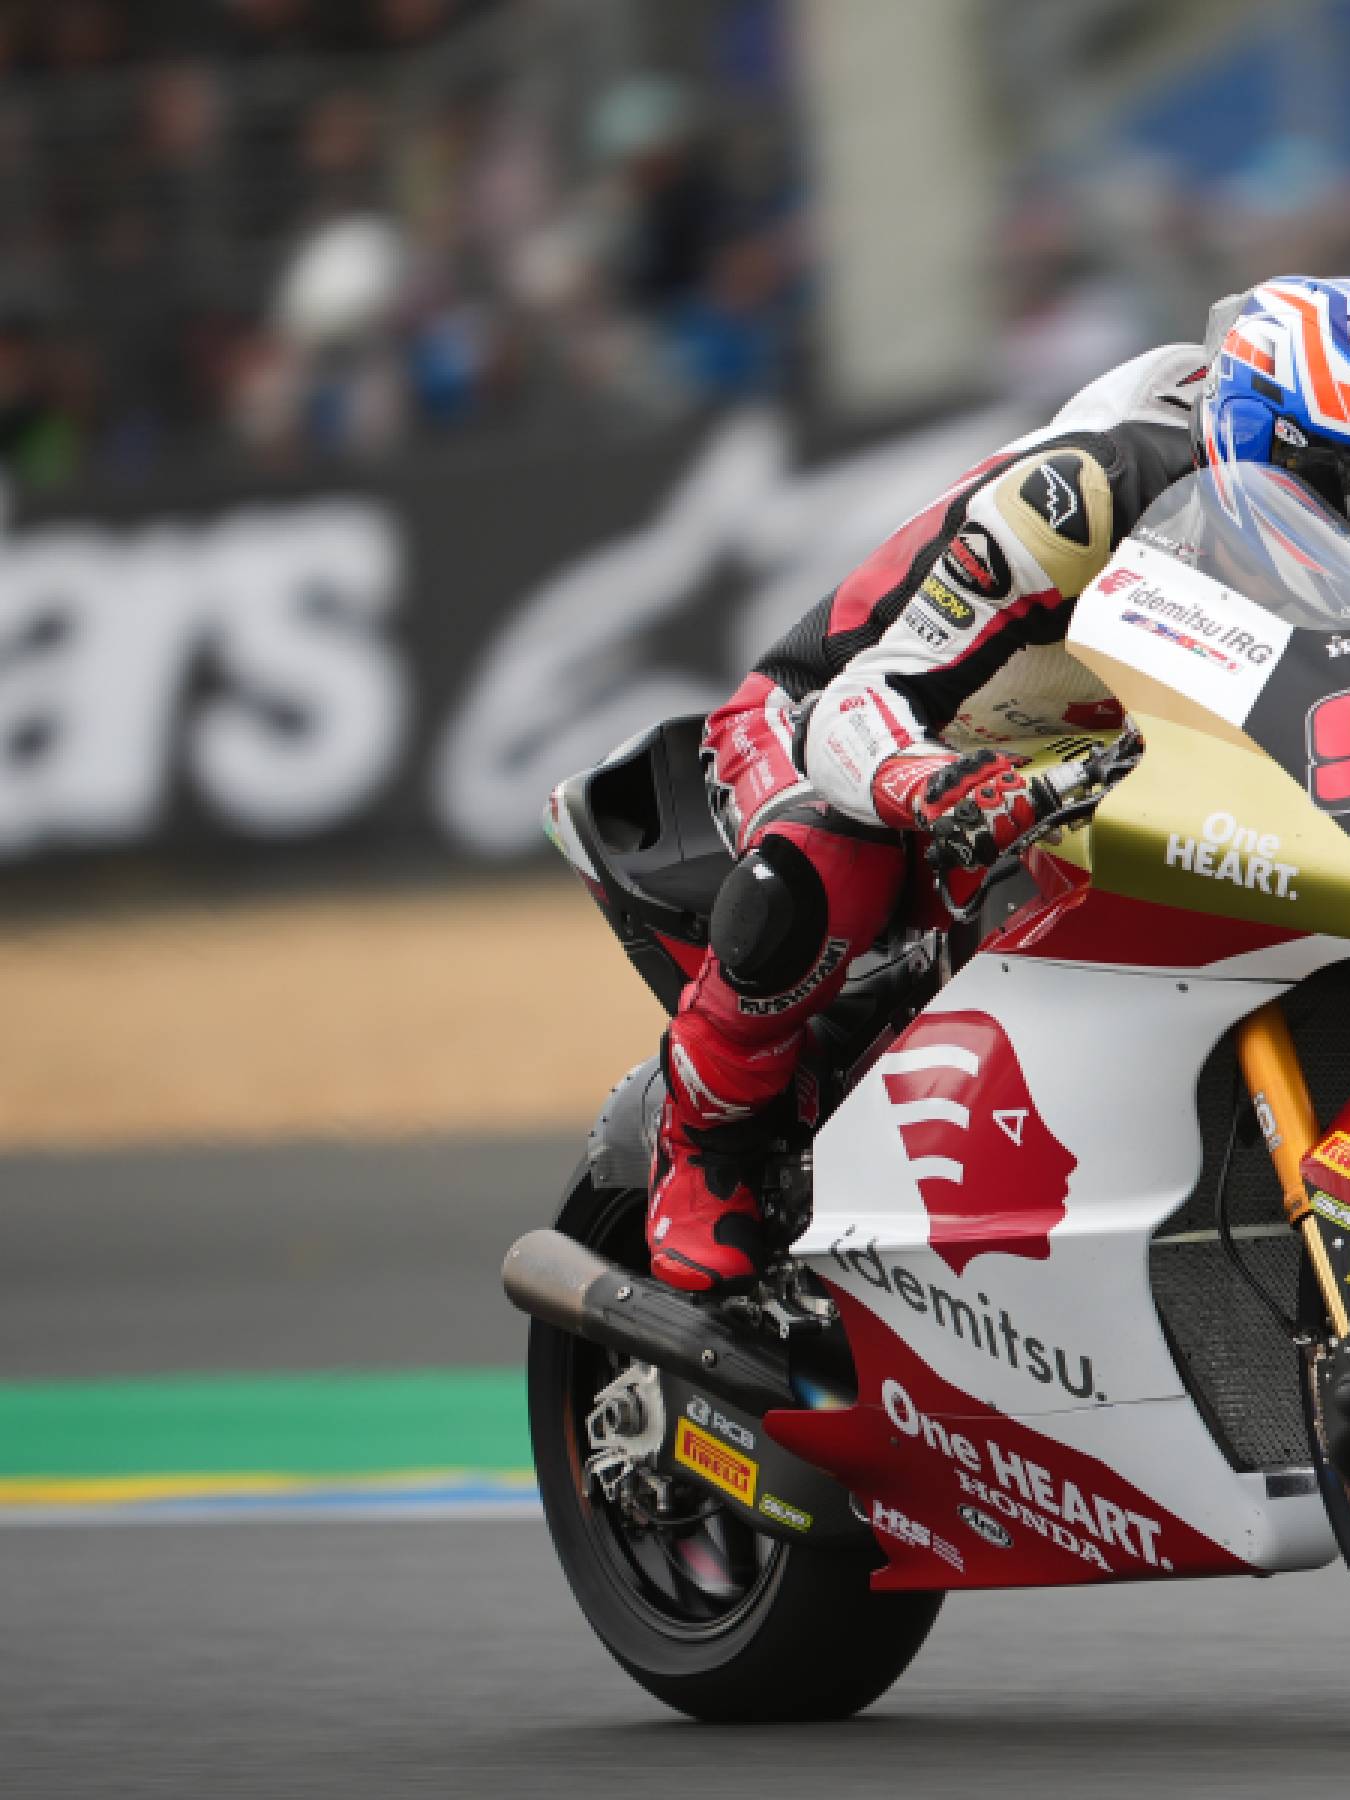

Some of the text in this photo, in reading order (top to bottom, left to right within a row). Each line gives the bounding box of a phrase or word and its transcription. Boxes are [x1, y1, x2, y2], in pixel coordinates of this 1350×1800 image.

[1127, 581, 1273, 665] idemitsu IRG
[1165, 833, 1299, 900] HEART.
[1203, 811, 1281, 859] One
[829, 1223, 1107, 1402] idemitsu.
[683, 1429, 751, 1494] PIRELLI
[881, 1378, 1174, 1570] One HEART.
[954, 1468, 1113, 1572] HONDA
